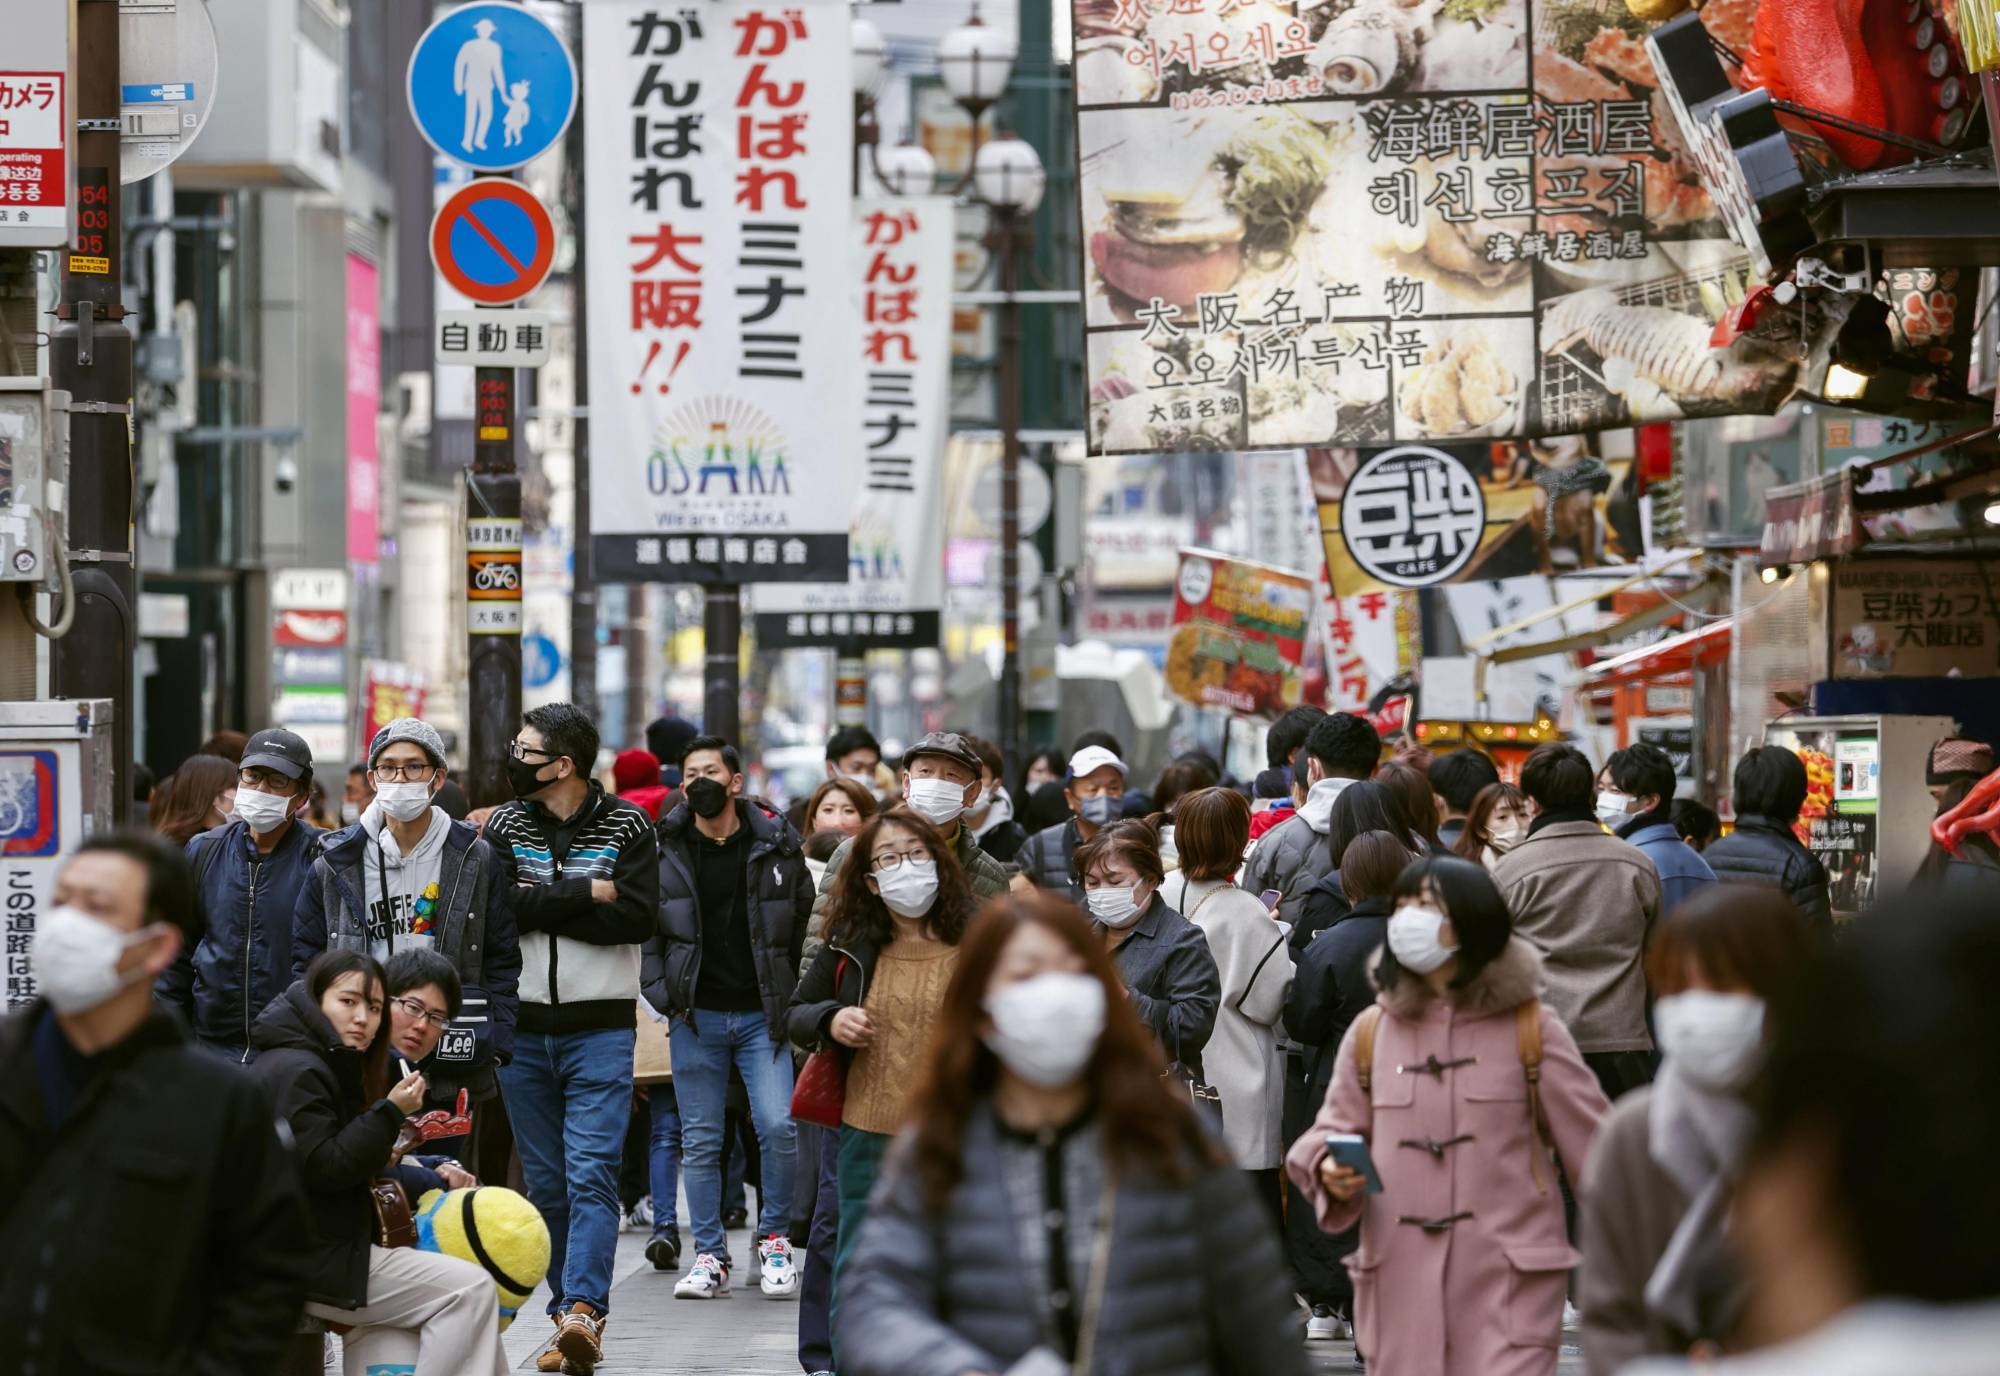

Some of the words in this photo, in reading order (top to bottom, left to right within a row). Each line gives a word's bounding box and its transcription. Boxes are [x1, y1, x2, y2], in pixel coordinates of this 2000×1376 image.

[1126, 21, 1316, 78] 어서오세요
[1171, 76, 1322, 111] いらっしゃいませ
[1367, 161, 1648, 226] 해선호프집
[1137, 276, 1424, 341] 大阪名产物
[442, 321, 544, 354] 自動車
[862, 208, 919, 493] がんばれミナミ
[1146, 329, 1428, 391] 오오사까특산품
[1148, 396, 1242, 424] 大阪名物
[646, 421, 791, 496] OSAKA
[1395, 557, 1438, 575] CAFE
[441, 1034, 473, 1054] Lee
